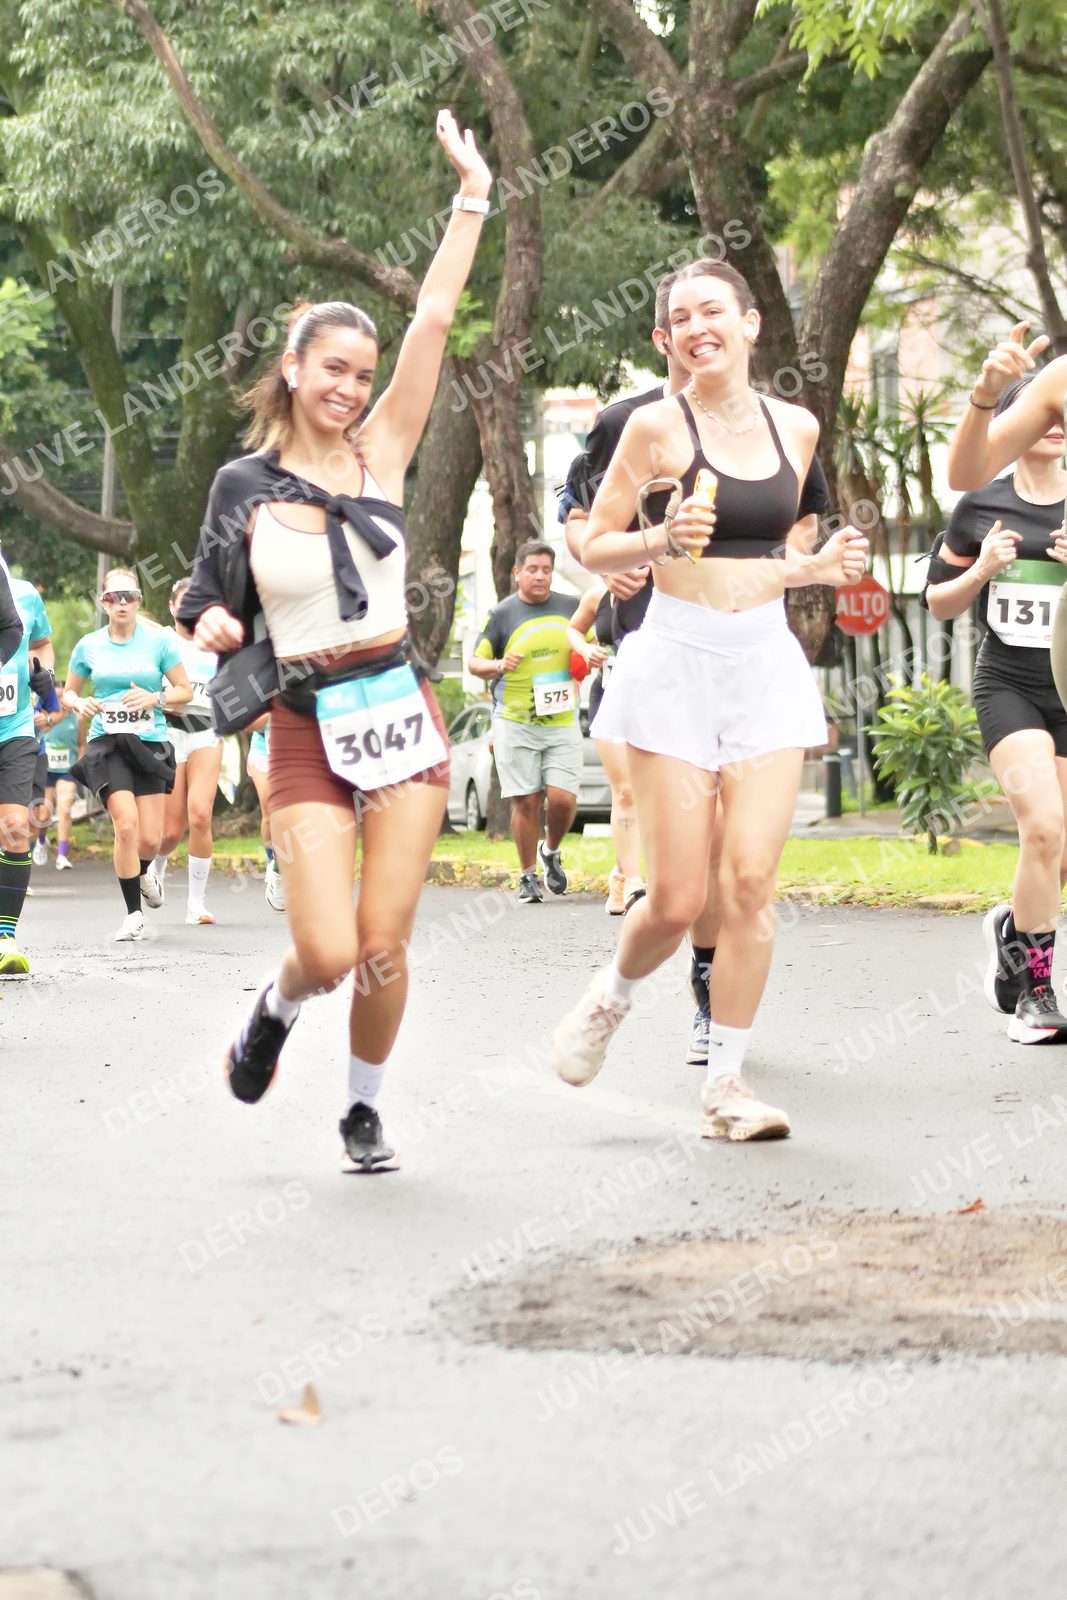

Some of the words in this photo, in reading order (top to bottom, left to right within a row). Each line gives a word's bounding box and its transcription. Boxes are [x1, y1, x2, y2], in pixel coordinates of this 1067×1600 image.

[835, 592, 885, 617] ALTO
[543, 689, 569, 704] 575
[106, 709, 151, 724] 3984
[335, 711, 424, 766] 3047
